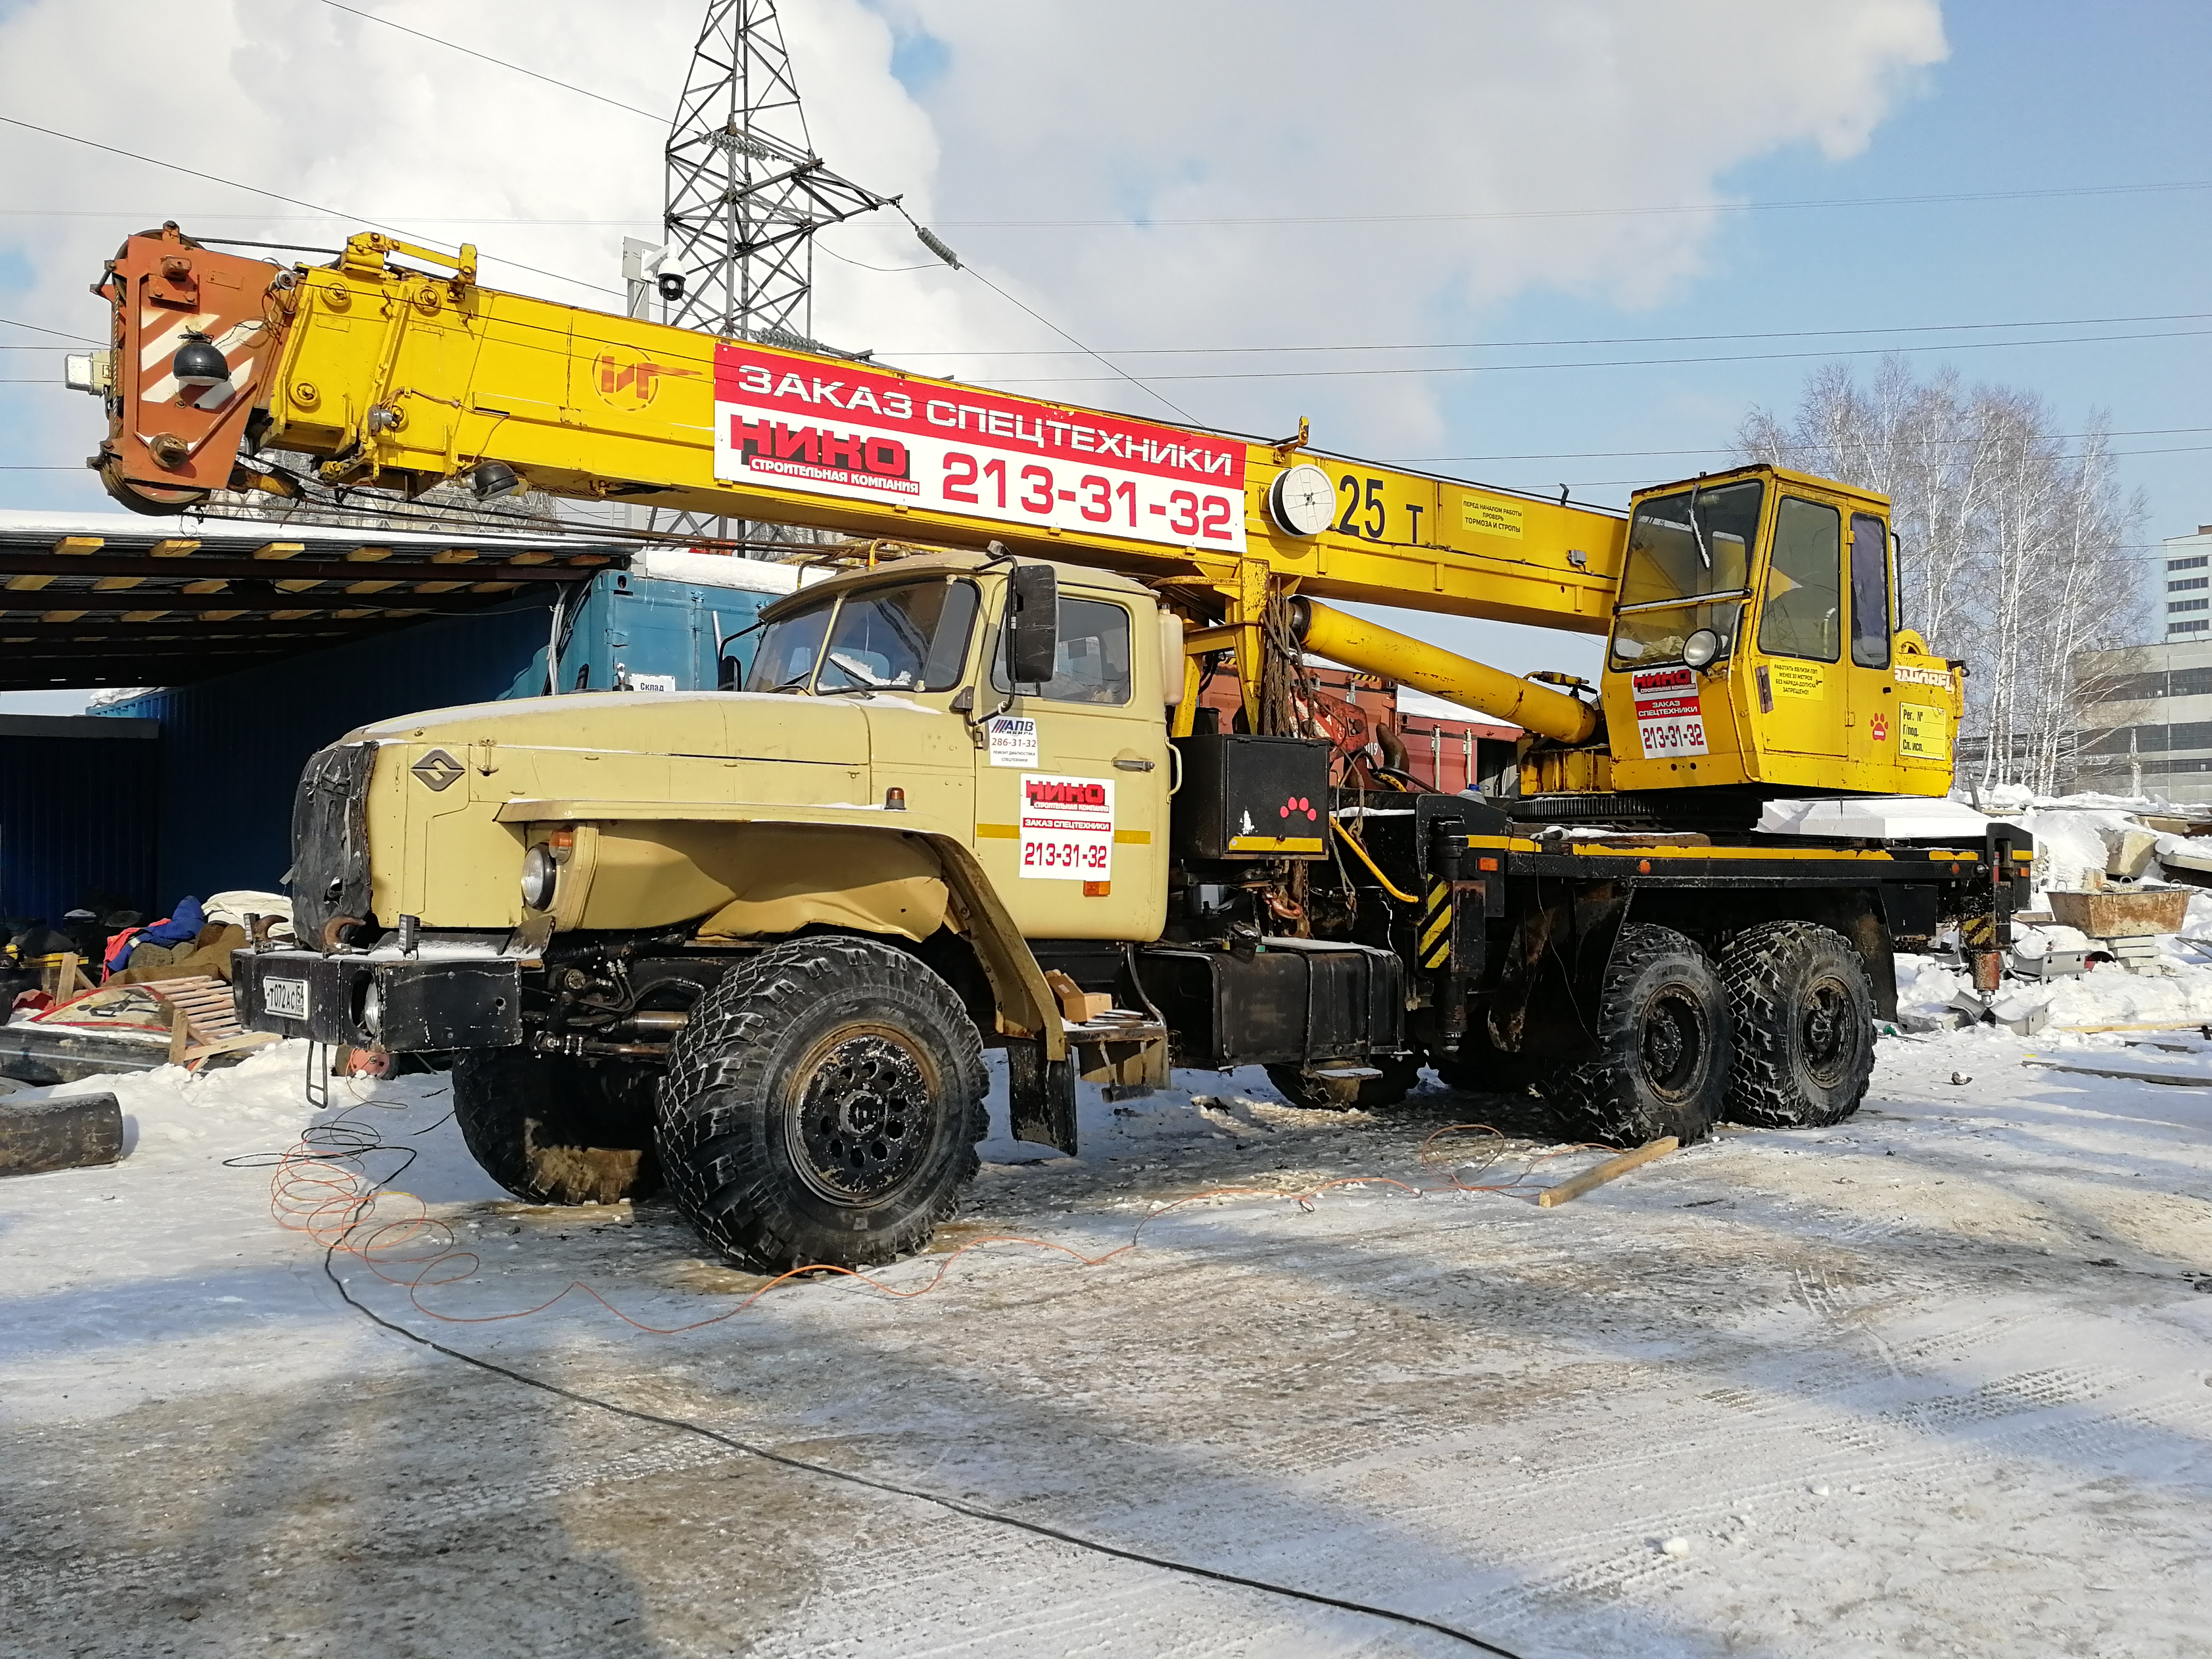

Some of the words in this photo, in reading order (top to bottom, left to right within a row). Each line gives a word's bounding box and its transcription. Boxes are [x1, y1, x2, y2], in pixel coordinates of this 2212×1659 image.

[738, 365, 912, 420] ЗАКАЗ
[926, 399, 1232, 476] СПЕЦТЕХНИКИ
[730, 413, 906, 475] НИКО
[751, 458, 848, 482] СТРОИТЕЛЬНАЯ
[851, 473, 919, 493] КОМПАНИЯ
[942, 451, 1232, 540] 213-31-32
[1339, 475, 1385, 538] 25
[1480, 504, 1502, 513] НАЧАЛОМ
[1465, 517, 1492, 528] ТОРМОЗА
[1498, 523, 1520, 533] СТРОПЫ
[1483, 512, 1504, 521] ПРОВЕРЬ
[1634, 669, 1690, 687] НИКО
[641, 683, 664, 691] Склад
[1638, 706, 1698, 716] СПЕЦТЕХНИКИ
[1904, 709, 1914, 721] Рег.
[992, 738, 1036, 747] 286-31-32
[1643, 724, 1704, 749] 213-31-32
[1026, 780, 1104, 804] НИКО
[1034, 801, 1078, 810] СТРОИТЕЛЬНАЯ
[1054, 821, 1109, 830] СПЕЦТЕХНИКИ
[1024, 842, 1106, 868] 213-31-32
